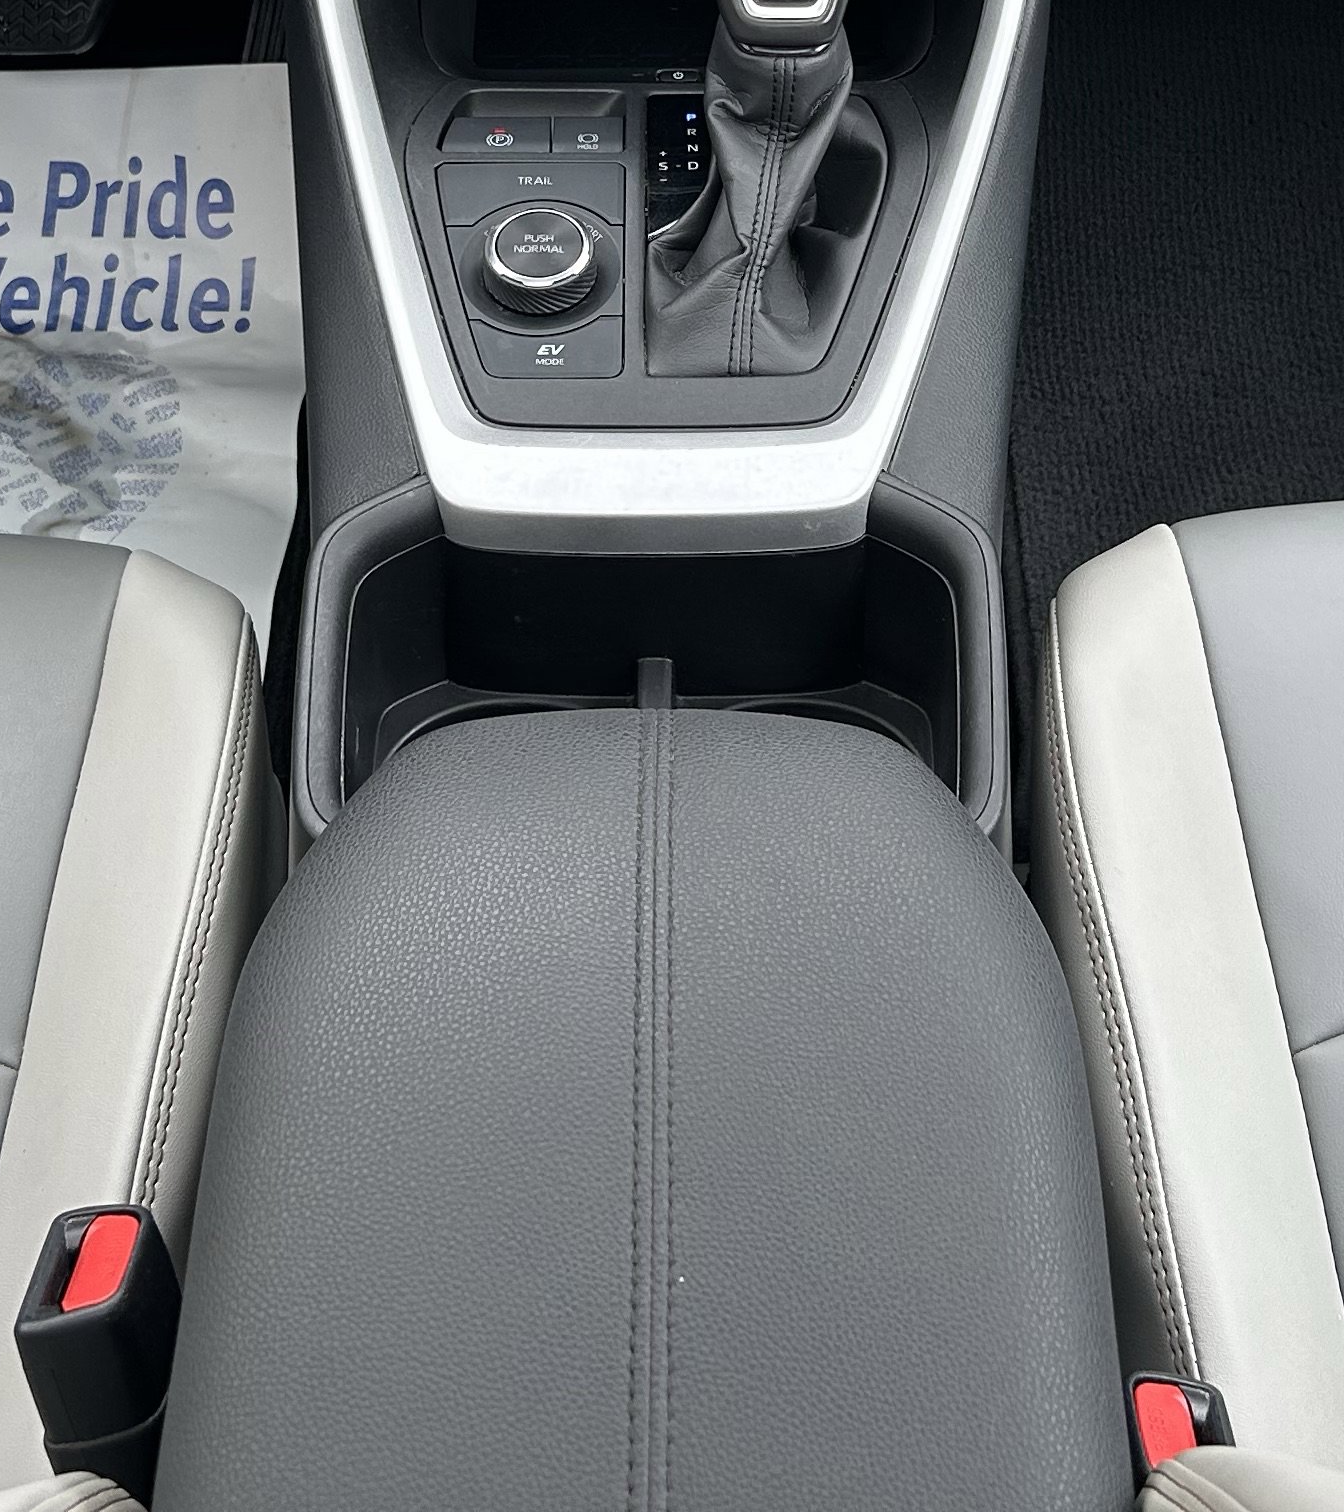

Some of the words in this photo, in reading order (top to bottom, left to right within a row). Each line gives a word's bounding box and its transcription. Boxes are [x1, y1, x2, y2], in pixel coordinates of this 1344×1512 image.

[686, 112, 697, 122] P
[686, 127, 697, 136] R
[686, 143, 698, 153] N
[657, 161, 669, 171] S
[687, 161, 699, 171] D
[517, 176, 553, 186] TRAIL
[41, 154, 235, 240] Pride
[523, 234, 555, 243] PUSH
[513, 244, 565, 254] NORMAL
[536, 343, 565, 356] EV
[535, 358, 565, 366] MODE
